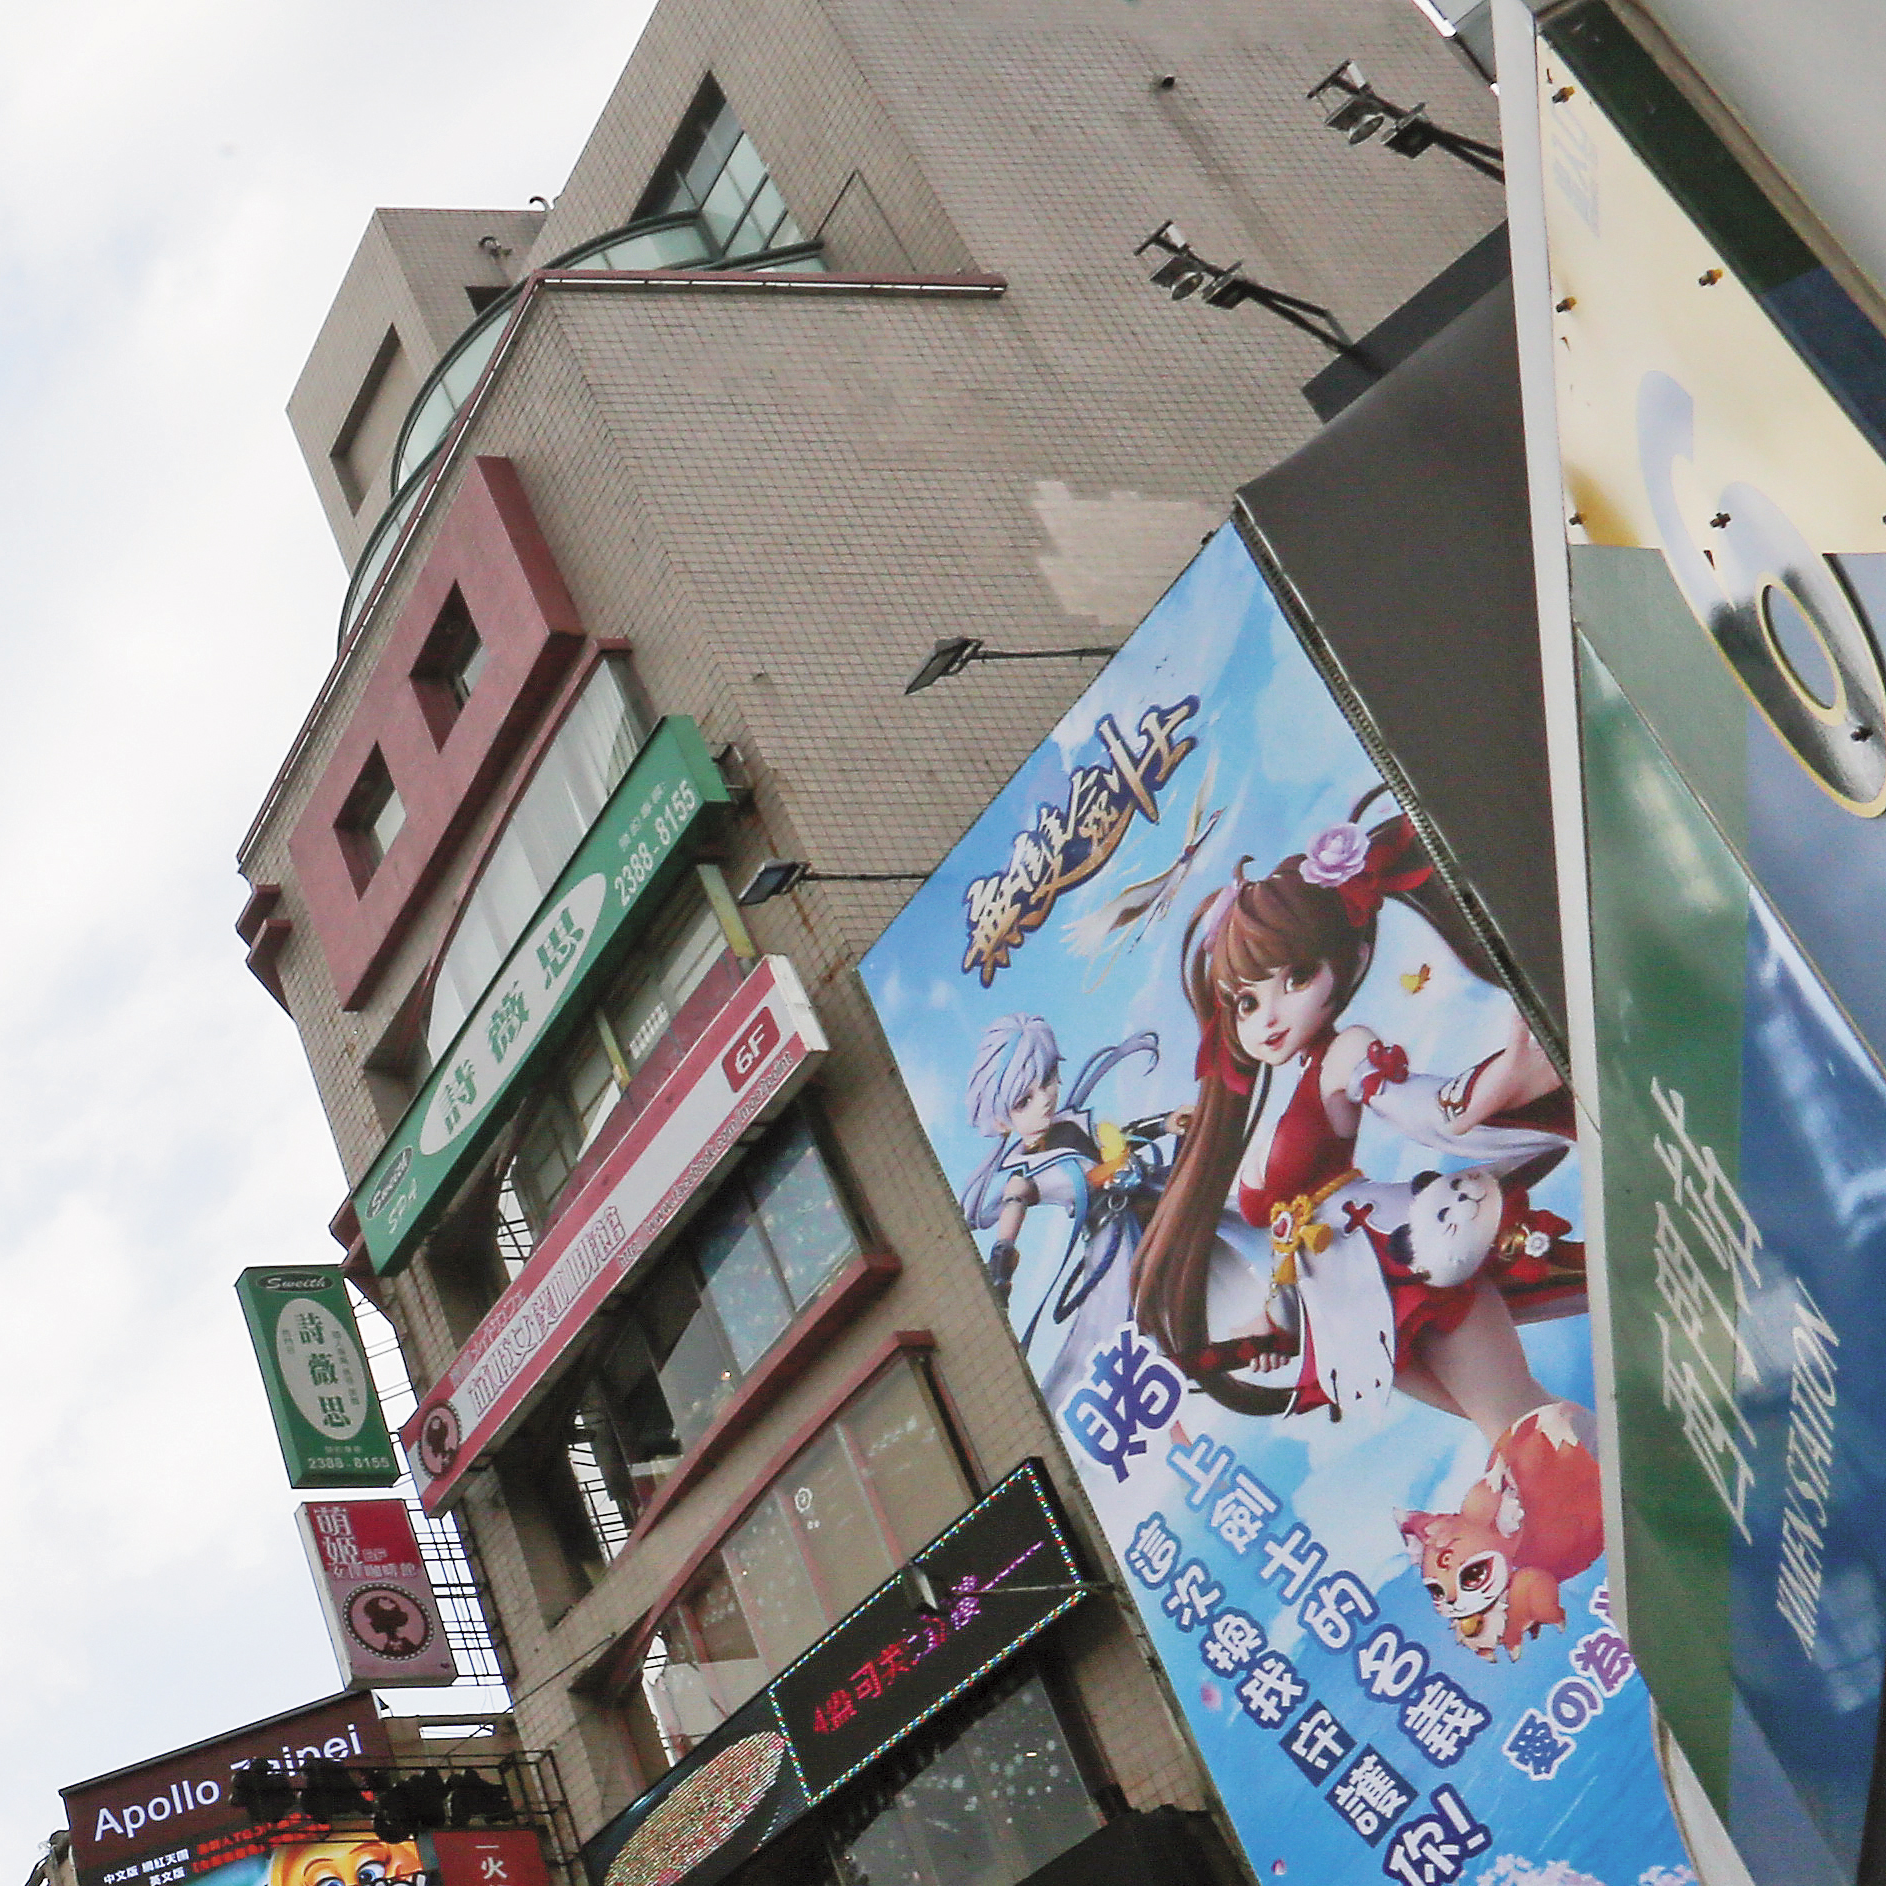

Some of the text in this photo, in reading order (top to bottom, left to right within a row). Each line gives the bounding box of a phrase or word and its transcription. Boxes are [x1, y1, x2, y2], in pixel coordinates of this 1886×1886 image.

[734, 1020, 770, 1076] 6F
[294, 1312, 352, 1431] 詩薇思
[94, 1779, 221, 1842] Apollo
